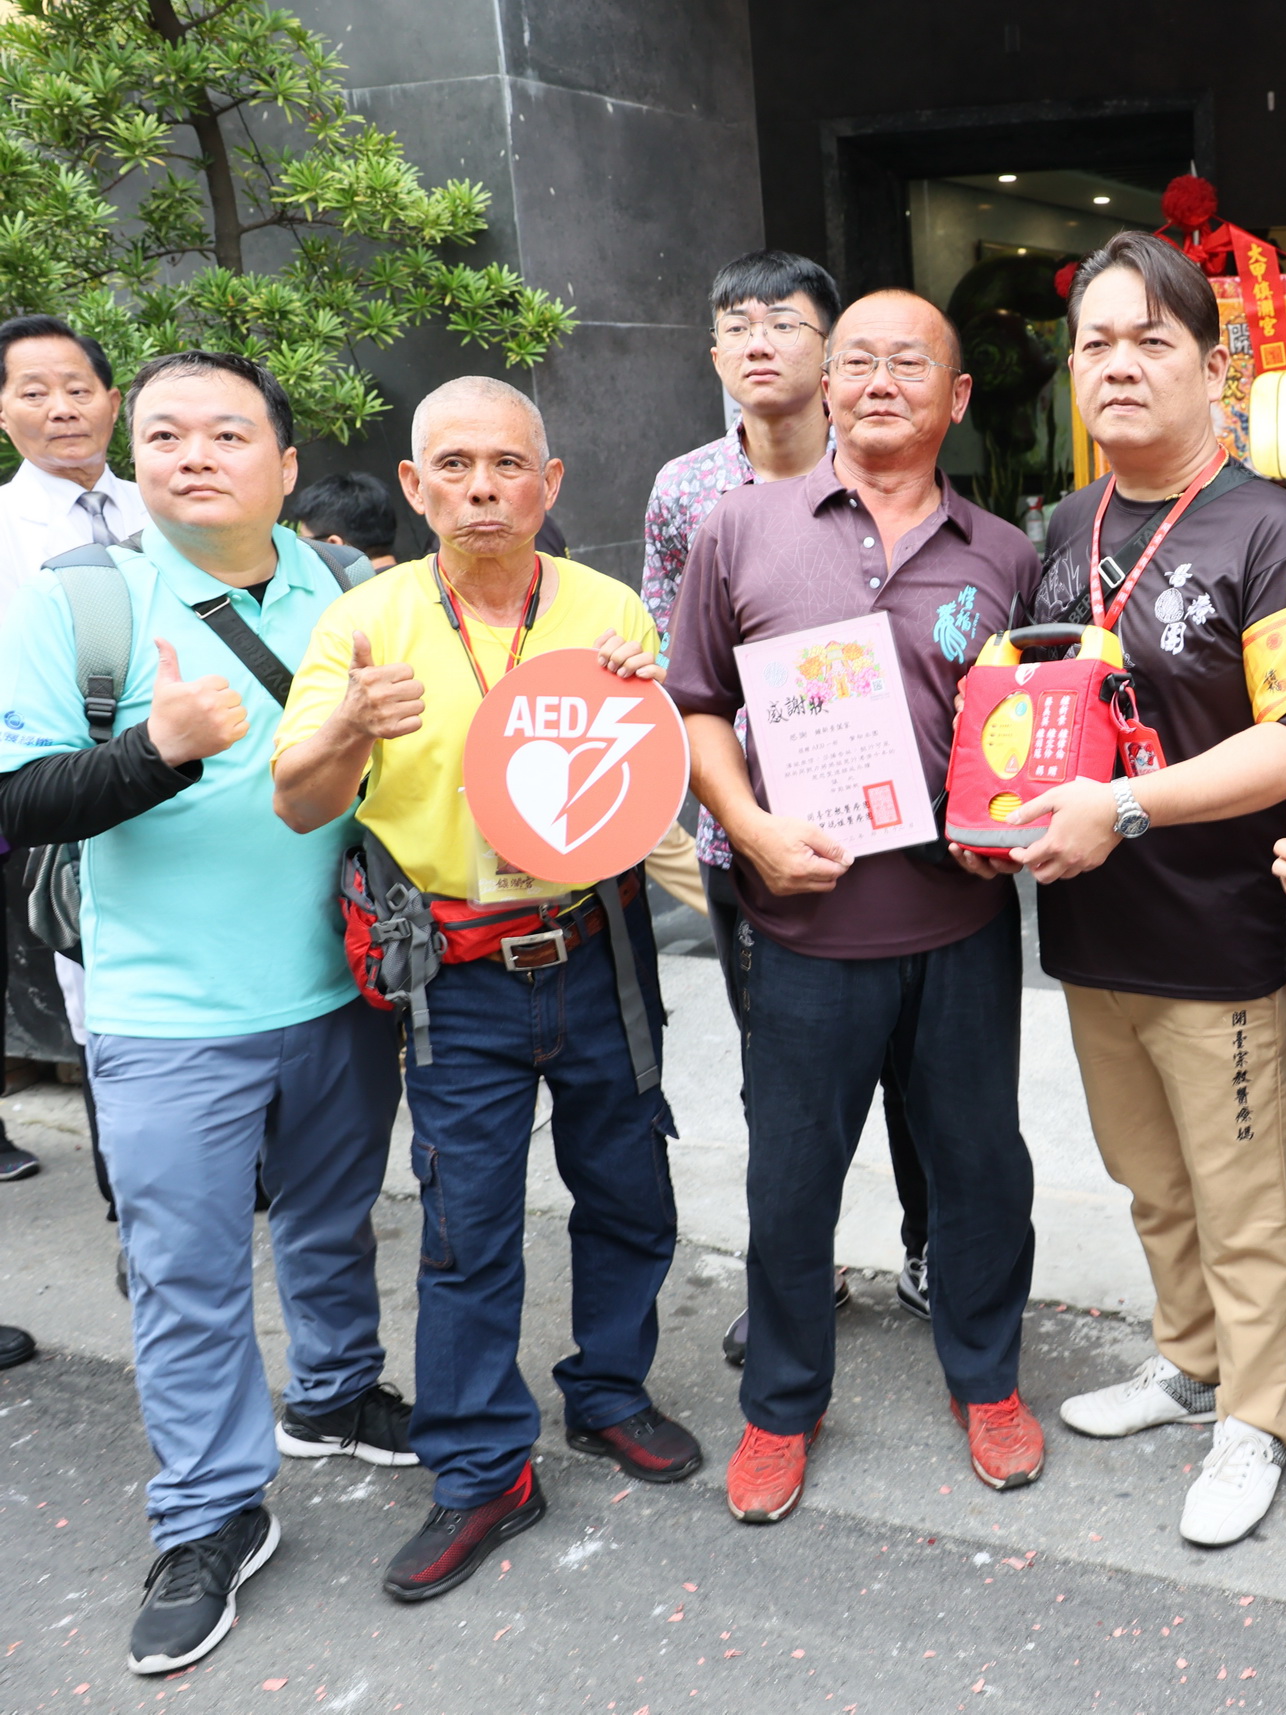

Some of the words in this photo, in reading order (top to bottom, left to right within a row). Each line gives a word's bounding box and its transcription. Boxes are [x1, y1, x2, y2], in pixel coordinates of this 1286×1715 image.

[1247, 243, 1278, 338] 大甲鎮瀾宮
[503, 695, 588, 738] AED
[767, 695, 830, 724] 感謝狀
